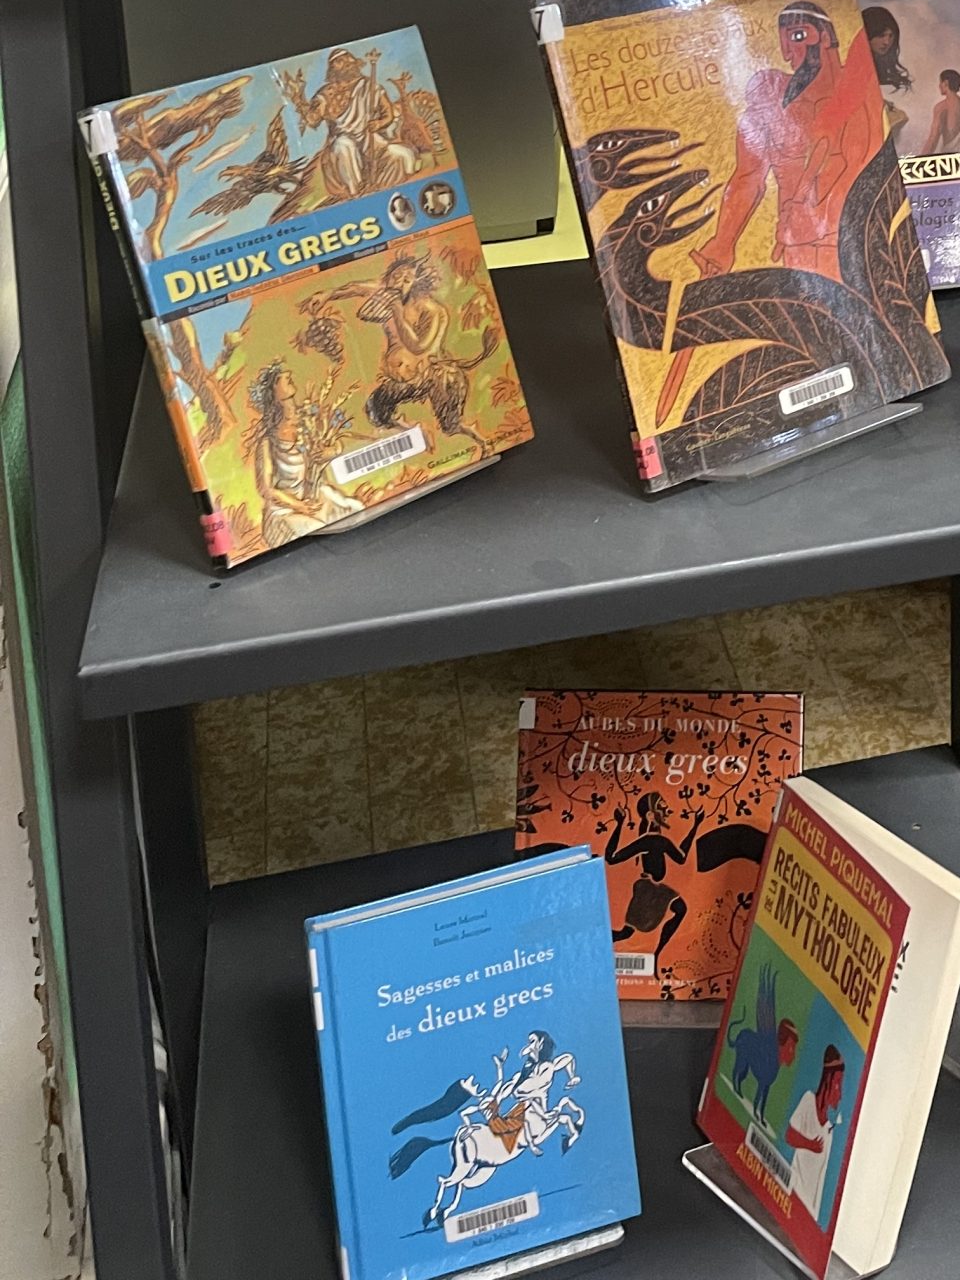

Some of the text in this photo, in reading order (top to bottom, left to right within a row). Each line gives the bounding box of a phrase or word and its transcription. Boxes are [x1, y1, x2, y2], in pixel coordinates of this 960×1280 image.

[570, 48, 612, 78] Les
[618, 30, 686, 64] douze
[581, 56, 722, 116] d'Hercule
[164, 250, 273, 303] DIEUX
[278, 216, 382, 266] GRECS
[190, 250, 211, 265] Sur
[214, 244, 233, 256] les
[236, 232, 273, 251] traces
[643, 717, 665, 734] DU
[676, 719, 743, 735] MONDE
[567, 740, 750, 786] dieux grecs
[785, 802, 893, 929] MICHEL PIQUEMAL
[773, 846, 886, 984] RÉCITS FABULEUX
[377, 948, 555, 1009] Sagesses et malices
[774, 885, 877, 1028] MYTHOLOGIE
[385, 982, 555, 1044] des dieux grecs
[735, 1142, 793, 1220] ALBIN MICHEL
